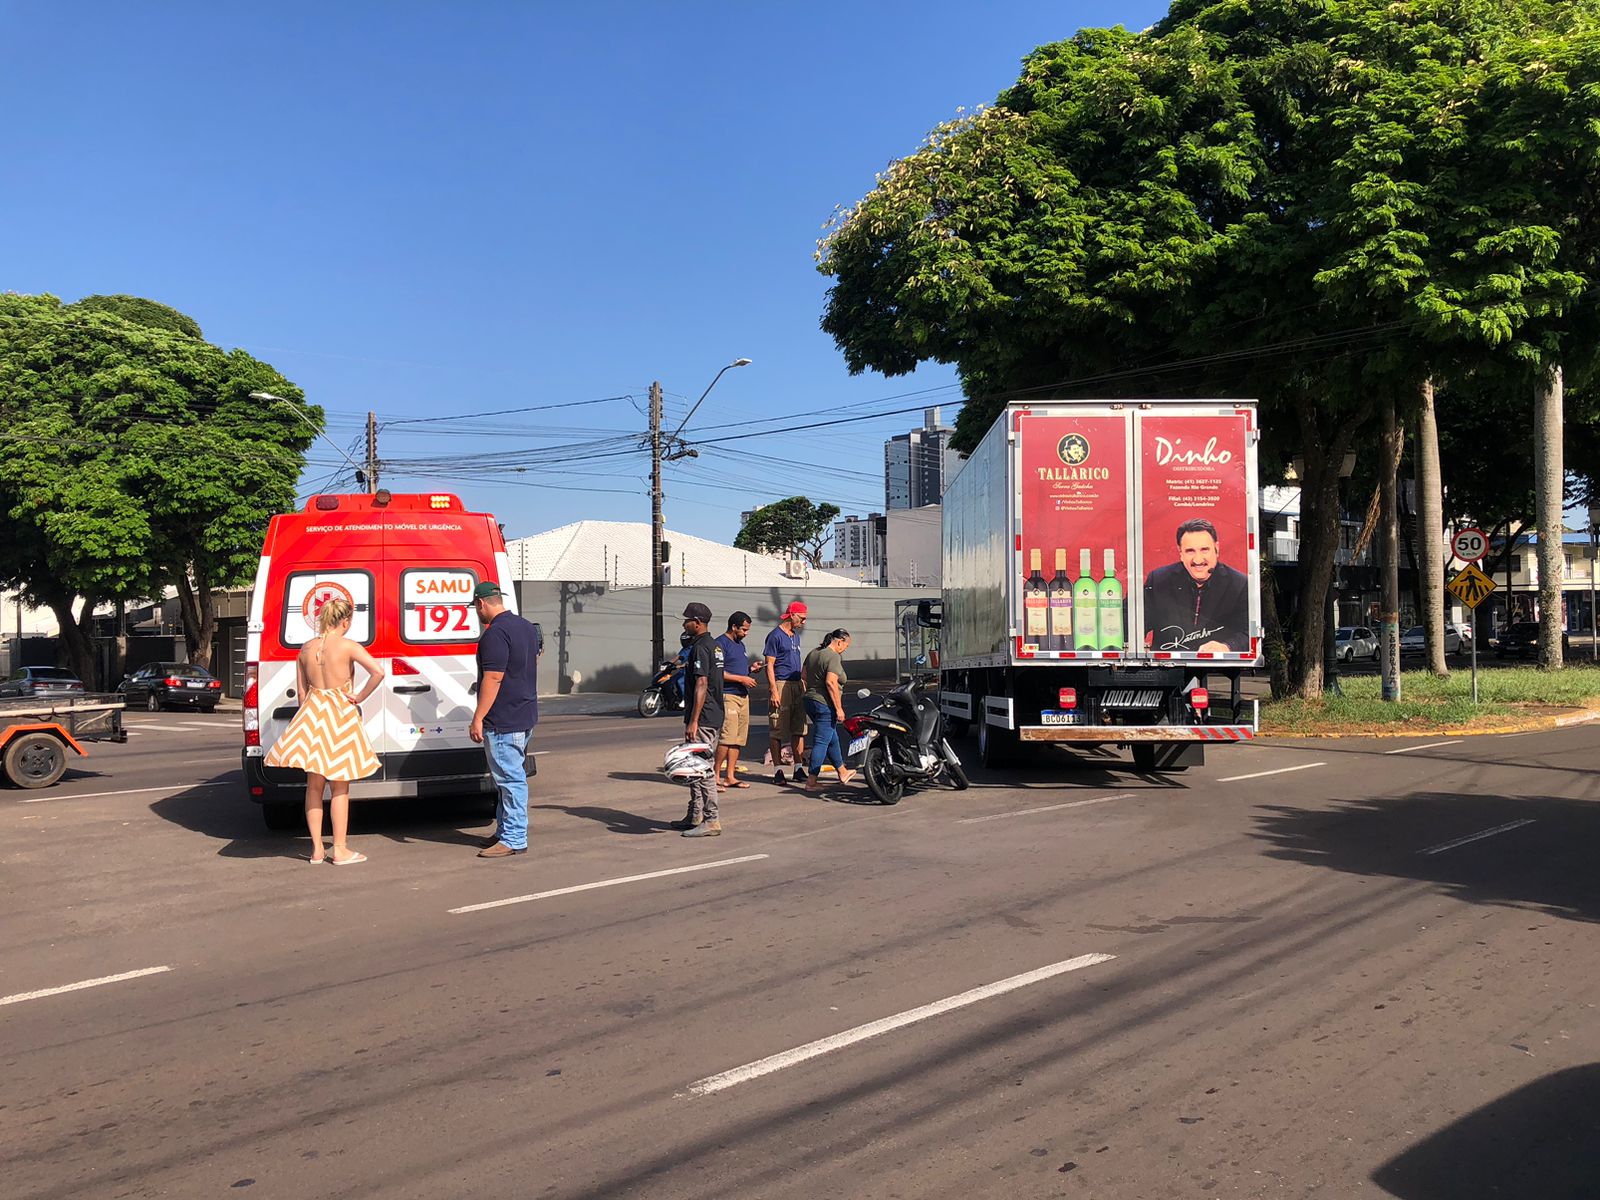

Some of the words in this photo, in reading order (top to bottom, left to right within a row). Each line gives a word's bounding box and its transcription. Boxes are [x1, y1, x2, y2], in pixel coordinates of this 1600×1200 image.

[1155, 436, 1232, 466] Dinho
[1037, 467, 1109, 480] TALLARICO
[305, 525, 334, 533] SERVIÇO
[428, 523, 463, 531] URGÊNCIA
[1457, 536, 1482, 551] 50
[416, 579, 471, 594] SAMU
[414, 604, 471, 633] 192
[1100, 690, 1135, 707] LOUCO
[1131, 690, 1164, 707] AMOR
